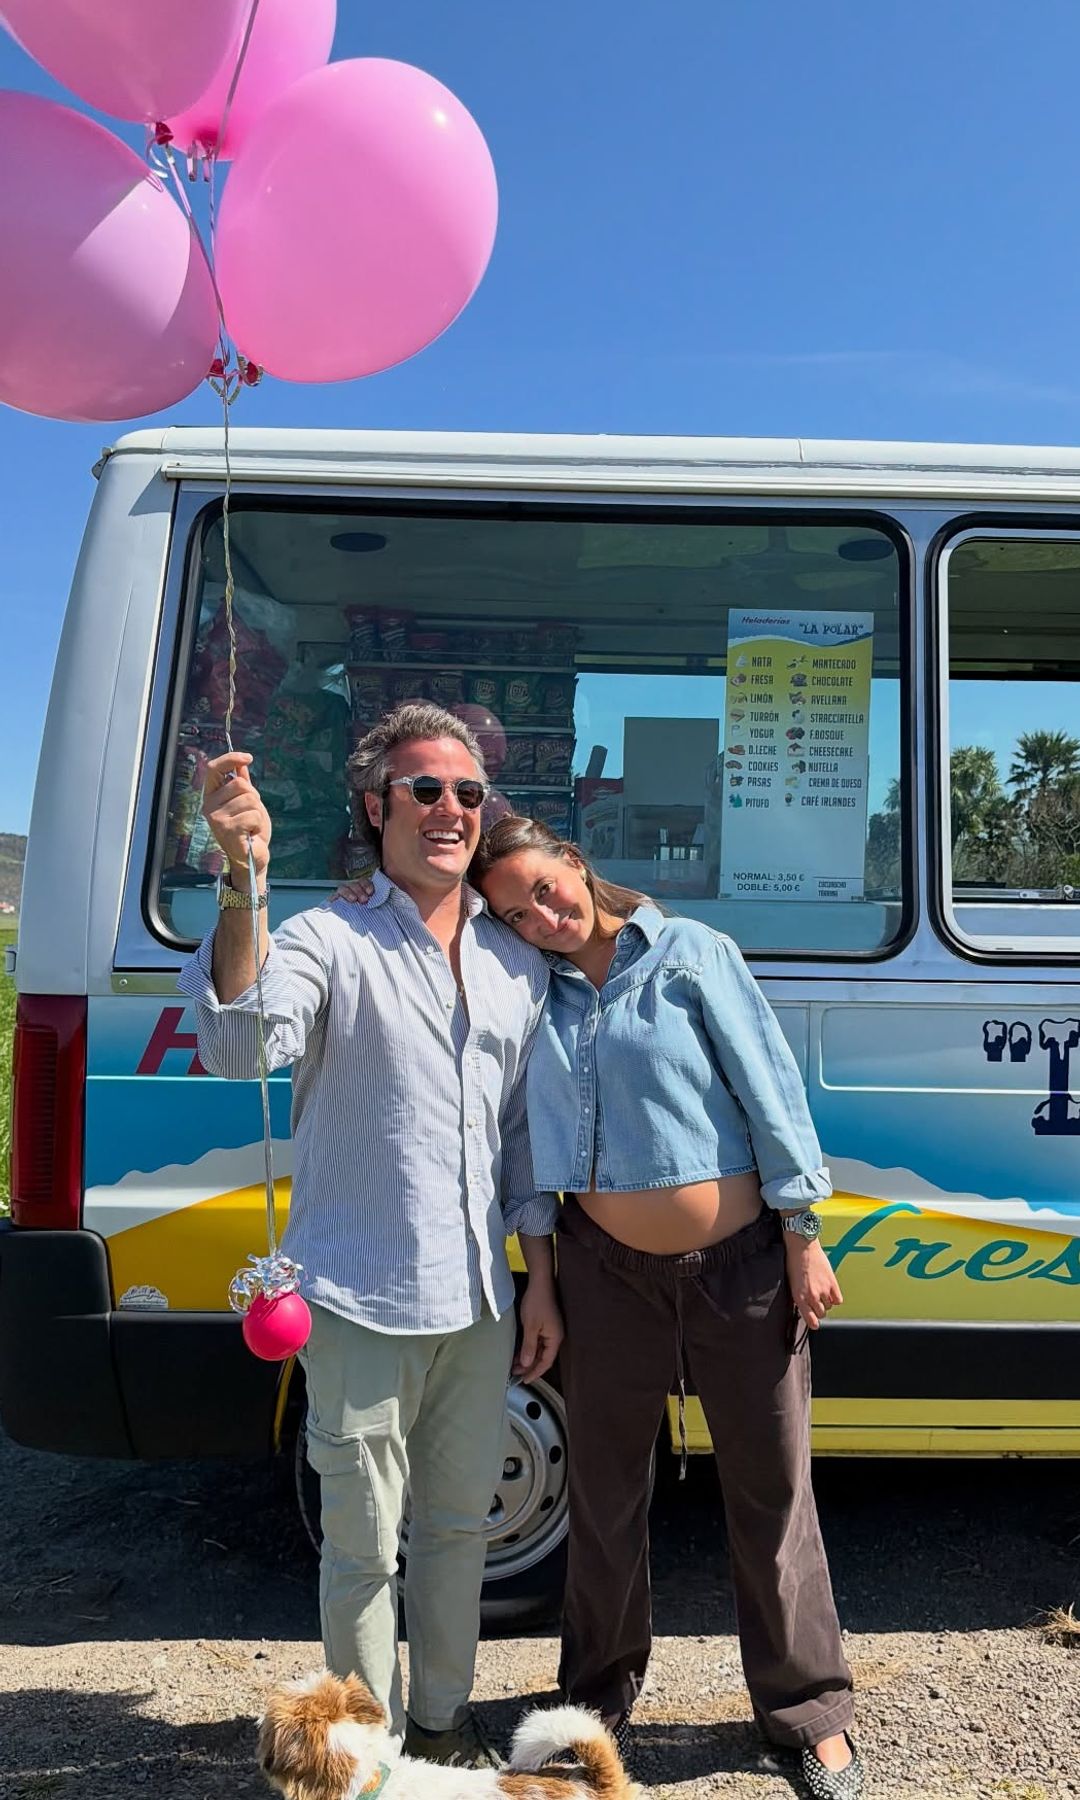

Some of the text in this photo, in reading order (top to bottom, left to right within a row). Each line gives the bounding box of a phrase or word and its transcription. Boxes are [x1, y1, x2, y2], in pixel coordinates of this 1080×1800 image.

[752, 656, 772, 667] NATA
[812, 659, 857, 670] MANTECADO
[751, 674, 774, 685] FRESA
[811, 676, 853, 687] CHOCOLATE
[811, 694, 847, 705] AVELLANA
[810, 713, 864, 724] STRACCIATELLA
[749, 728, 774, 739] YOGUR
[748, 745, 777, 755] D.LECHE
[809, 747, 853, 757] CHEESECAKE
[748, 762, 779, 772] COOKIES
[808, 762, 839, 773] NUTELLA
[747, 777, 772, 788] PASAS
[808, 778, 862, 788] CREMA DE QUESO
[745, 798, 769, 808] PITUFO
[801, 796, 819, 806] CAFÉ
[733, 872, 775, 881] NORMAL:
[777, 872, 797, 882] 3,50
[737, 883, 772, 891] DOBLE:
[773, 884, 793, 892] 5,00
